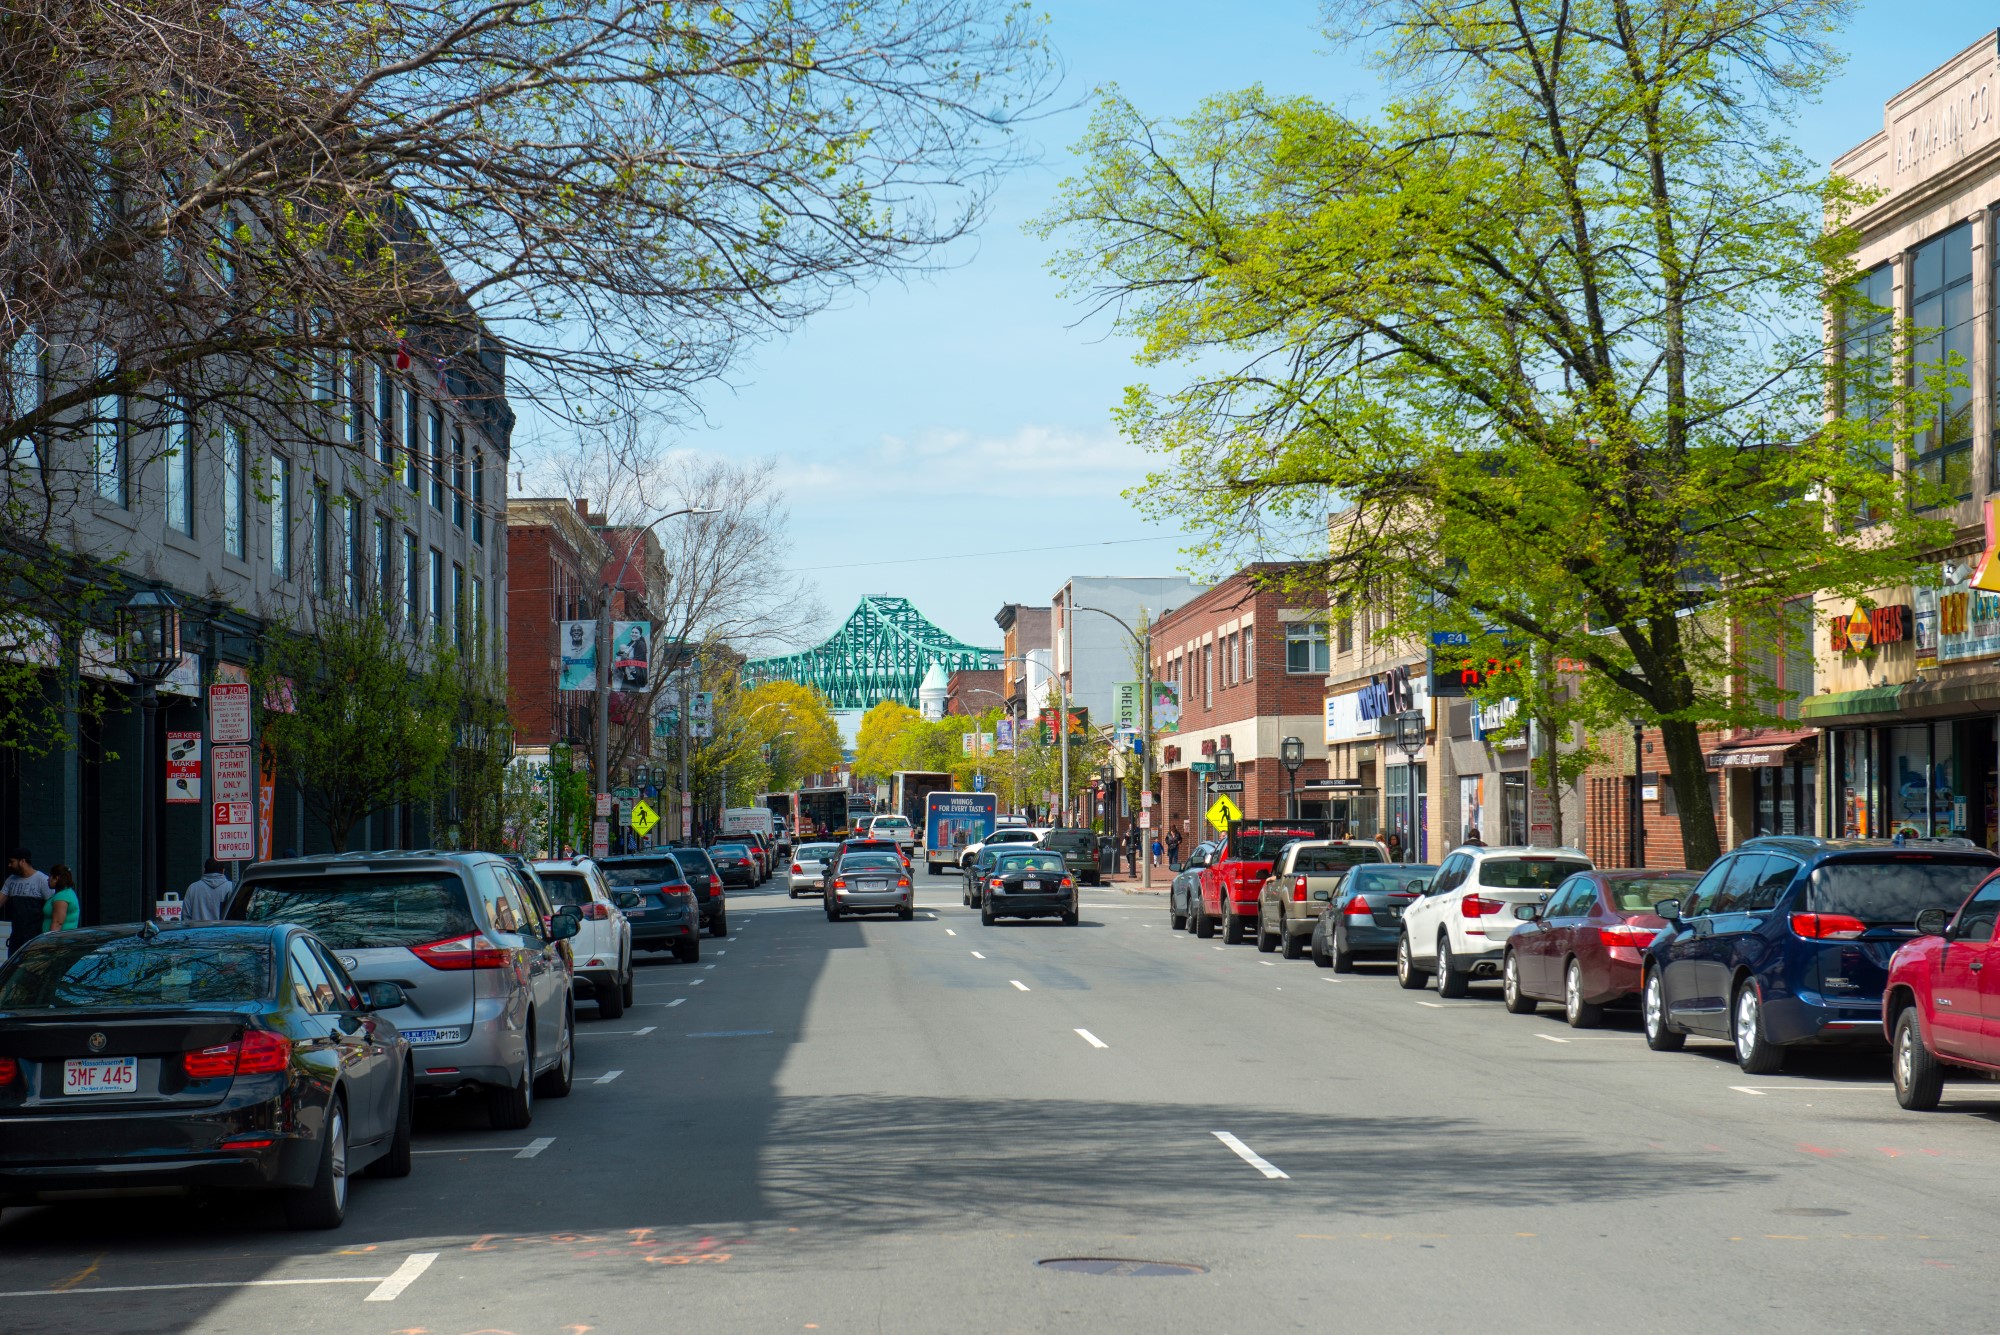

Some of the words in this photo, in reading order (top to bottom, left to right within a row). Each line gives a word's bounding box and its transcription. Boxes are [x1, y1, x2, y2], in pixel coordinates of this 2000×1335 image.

[1831, 614, 1848, 651] LAS
[1871, 604, 1903, 645] VEGAS
[213, 687, 226, 695] TOW
[230, 686, 247, 694] ZONE
[1122, 686, 1132, 729] CHELSEA
[1046, 711, 1055, 744] CHELSEA
[216, 751, 247, 759] RESIDENT
[220, 761, 244, 769] PERMIT
[218, 771, 246, 779] PARKING
[219, 806, 226, 817] 2
[219, 843, 249, 851] ENFORCED
[167, 907, 181, 915] REP
[68, 1068, 97, 1085] 3MF
[103, 1066, 132, 1084] 445
